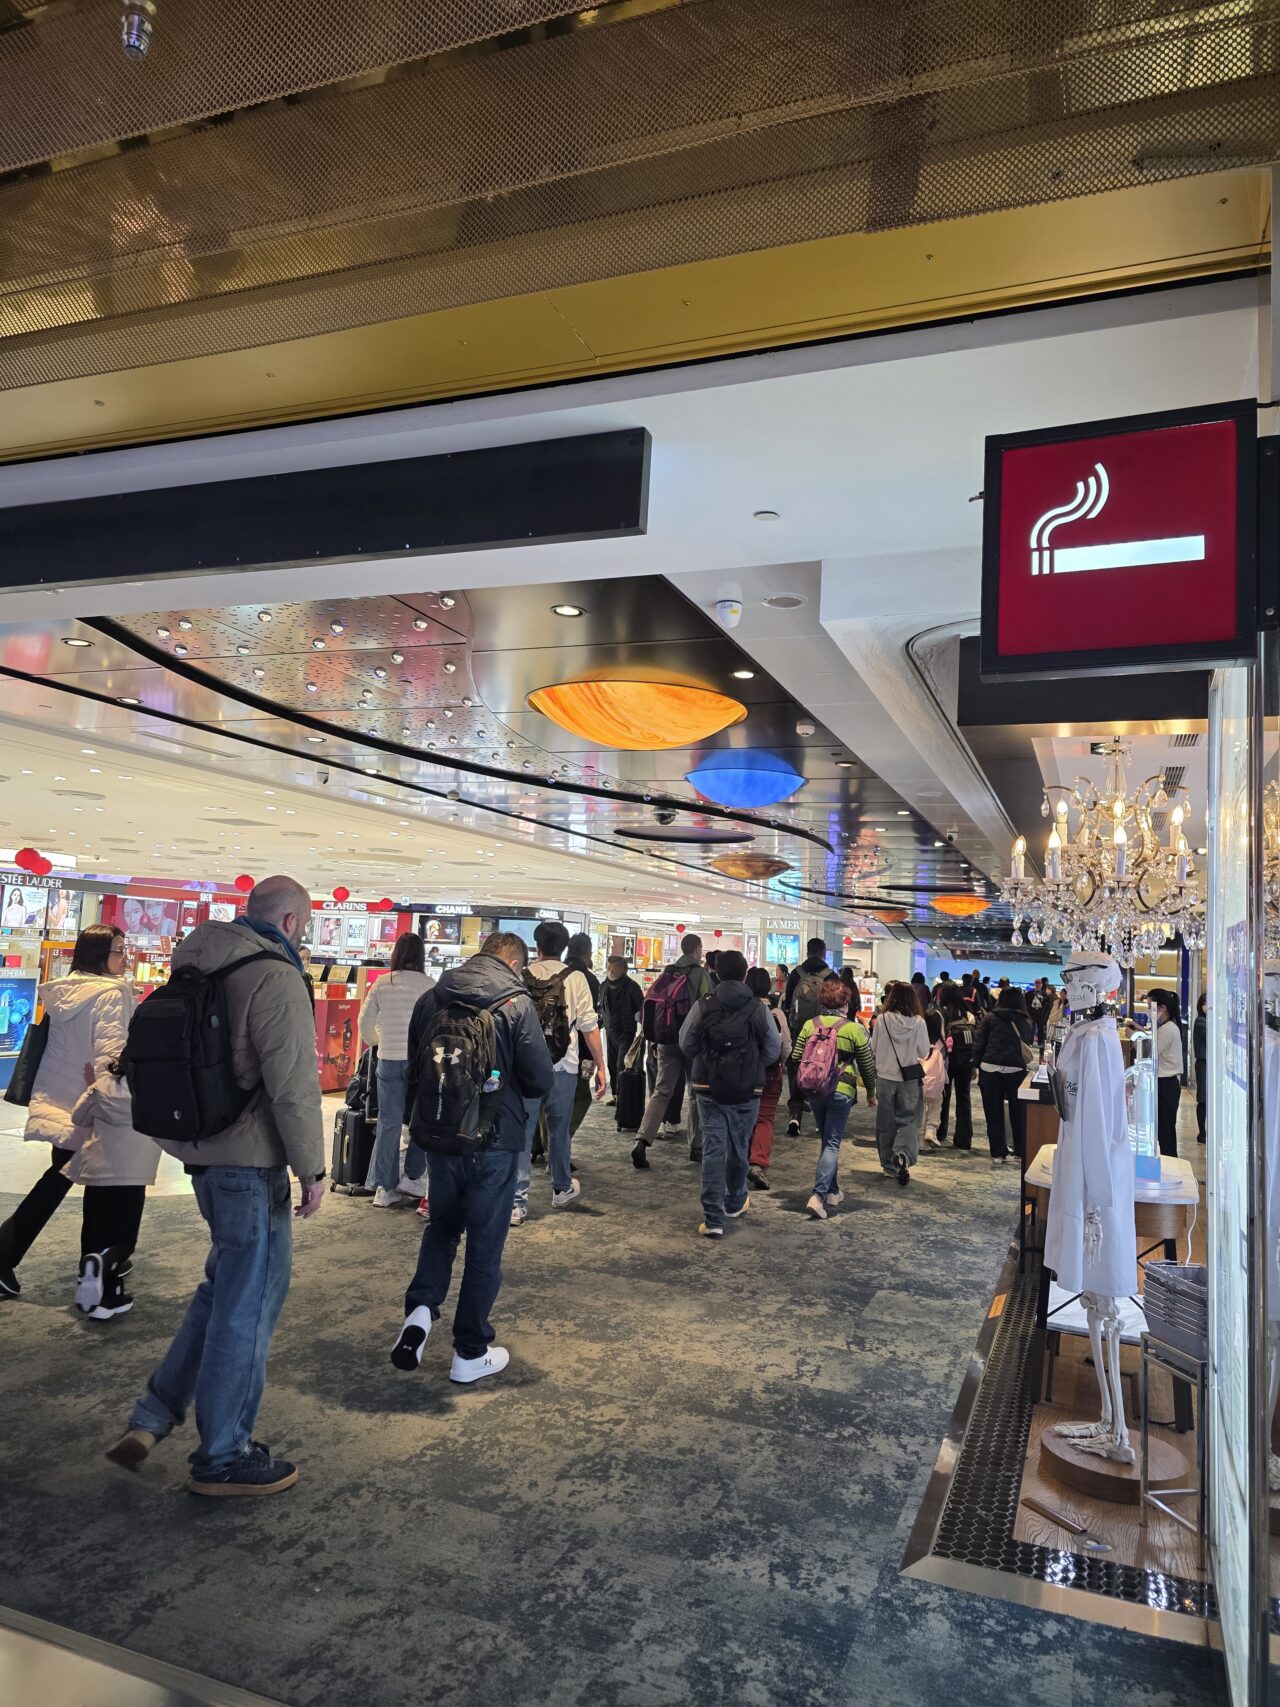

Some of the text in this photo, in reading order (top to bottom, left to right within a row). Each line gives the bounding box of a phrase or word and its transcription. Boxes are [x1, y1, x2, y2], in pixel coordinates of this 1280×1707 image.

[26, 876, 63, 889] LAUDER
[322, 901, 367, 911] CLARINS
[435, 904, 474, 915] CHANEL
[766, 919, 801, 930] LA MER
